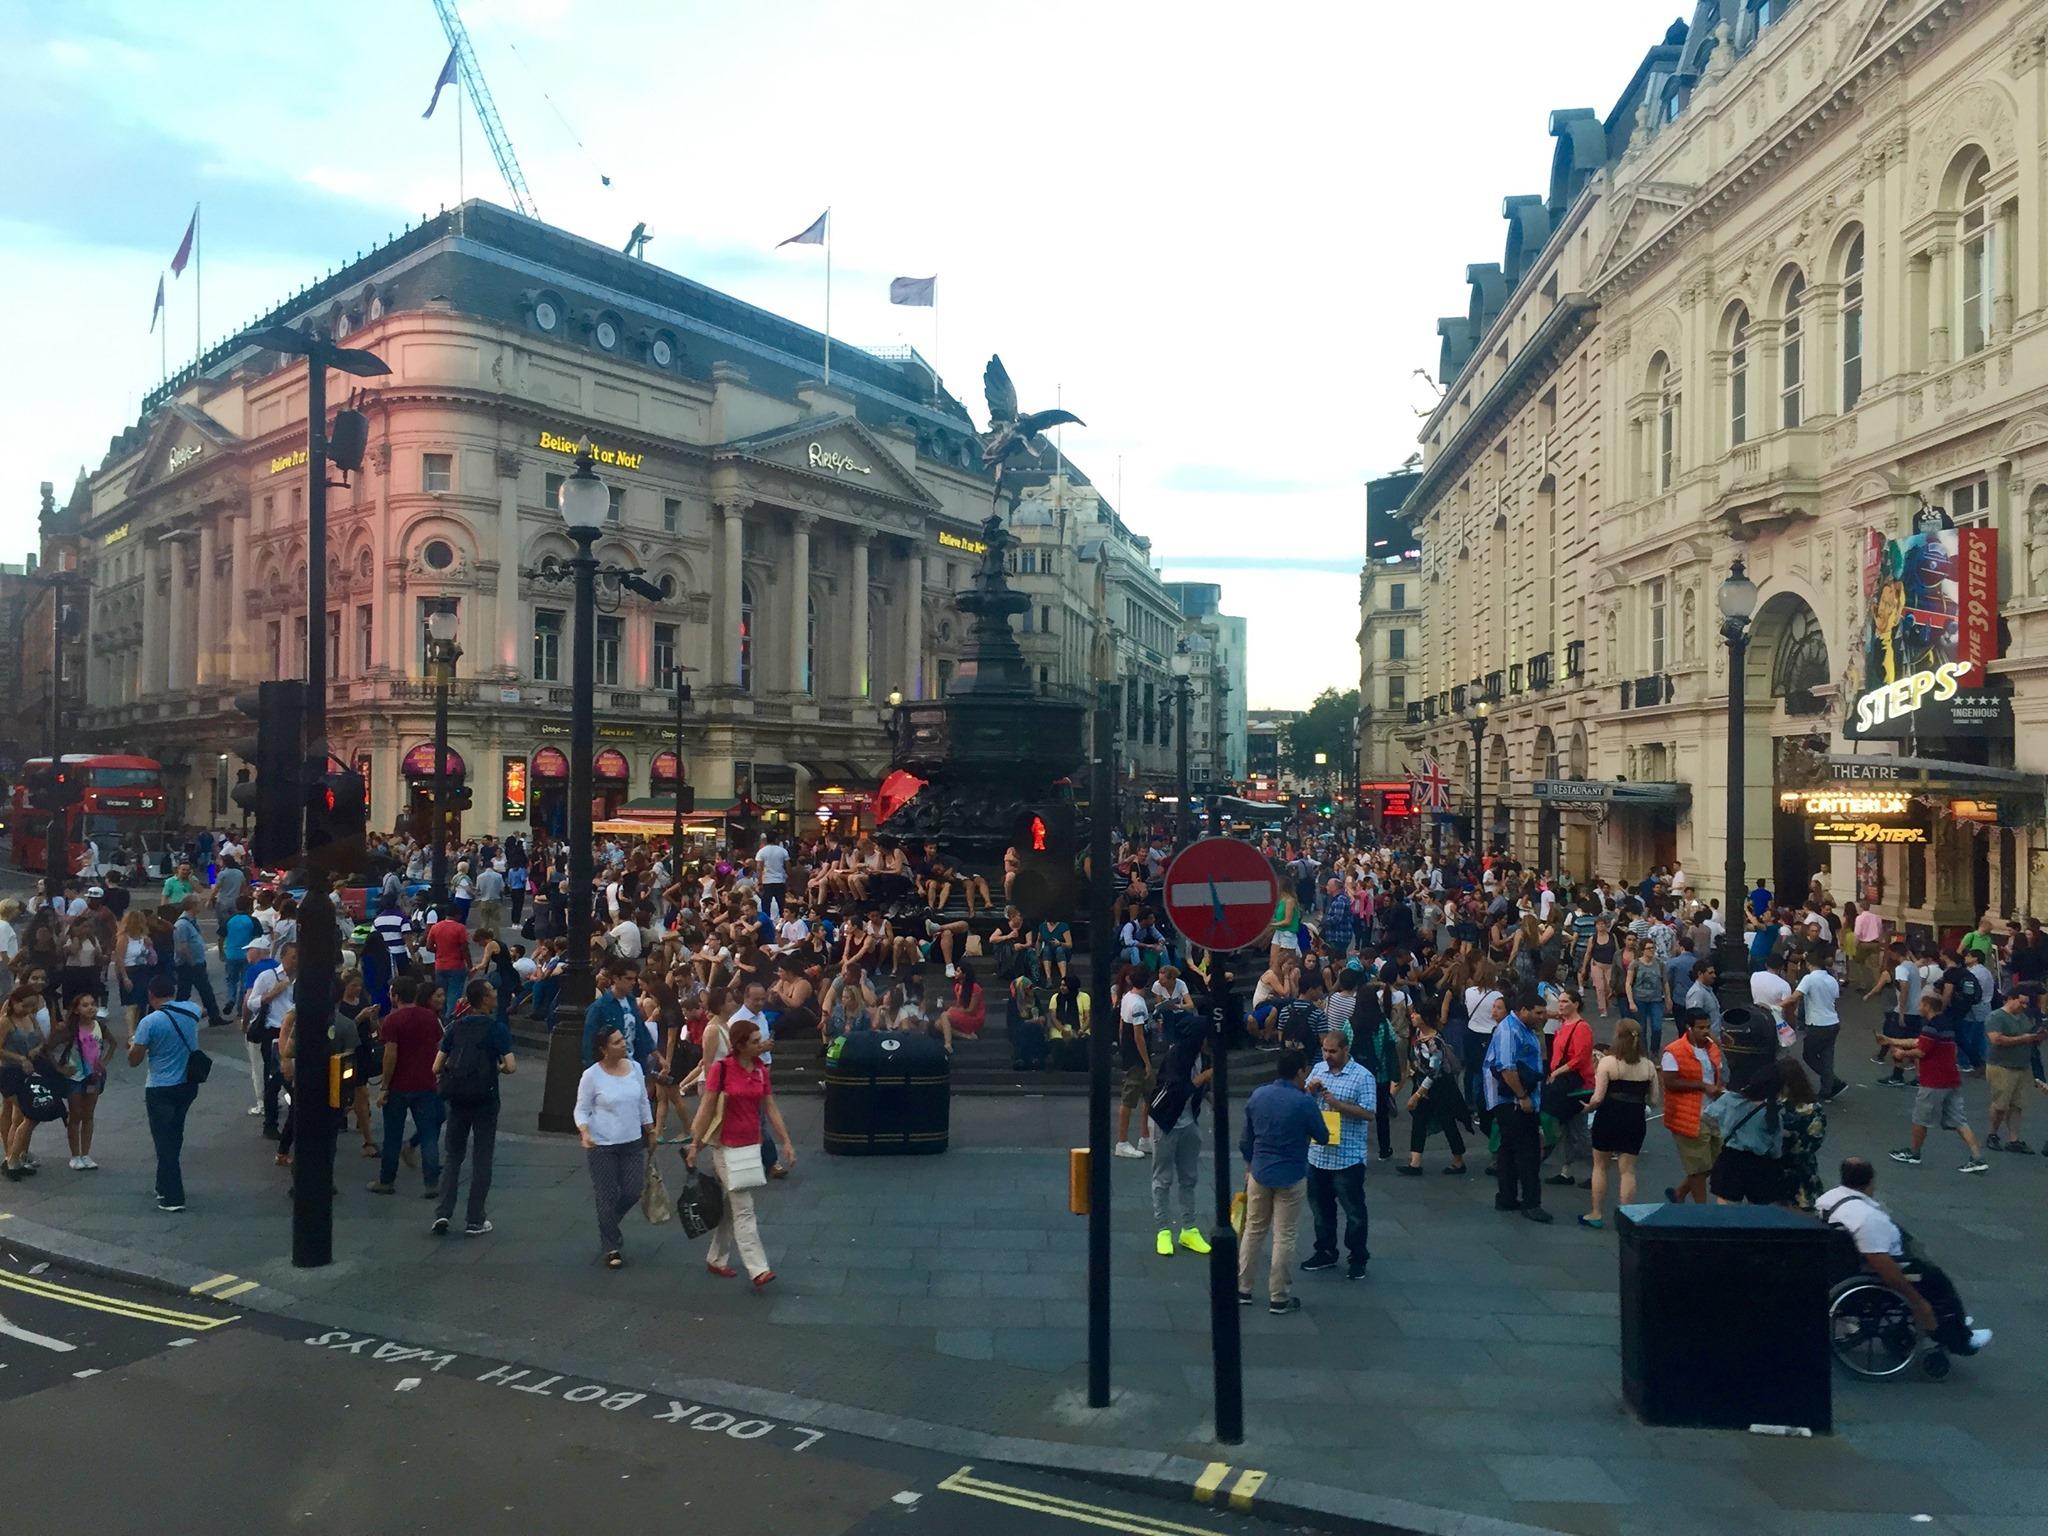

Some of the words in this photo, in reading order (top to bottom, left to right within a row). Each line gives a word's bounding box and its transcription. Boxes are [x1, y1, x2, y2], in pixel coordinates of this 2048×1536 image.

[540, 431, 580, 455] Believ
[587, 443, 599, 460] It
[600, 450, 615, 463] or
[615, 450, 642, 469] Not!
[1968, 601, 1989, 632] 39
[1856, 660, 1973, 733] STEPS'
[1831, 763, 1900, 780] THEATRE
[140, 799, 153, 808] 38
[1553, 784, 1602, 795] RESTAURANT
[1849, 823, 1880, 842] 39
[1213, 1007, 1223, 1020] S
[303, 1330, 458, 1372] WAYS
[476, 1364, 648, 1412] BOTH
[652, 1400, 826, 1453] LOOK
